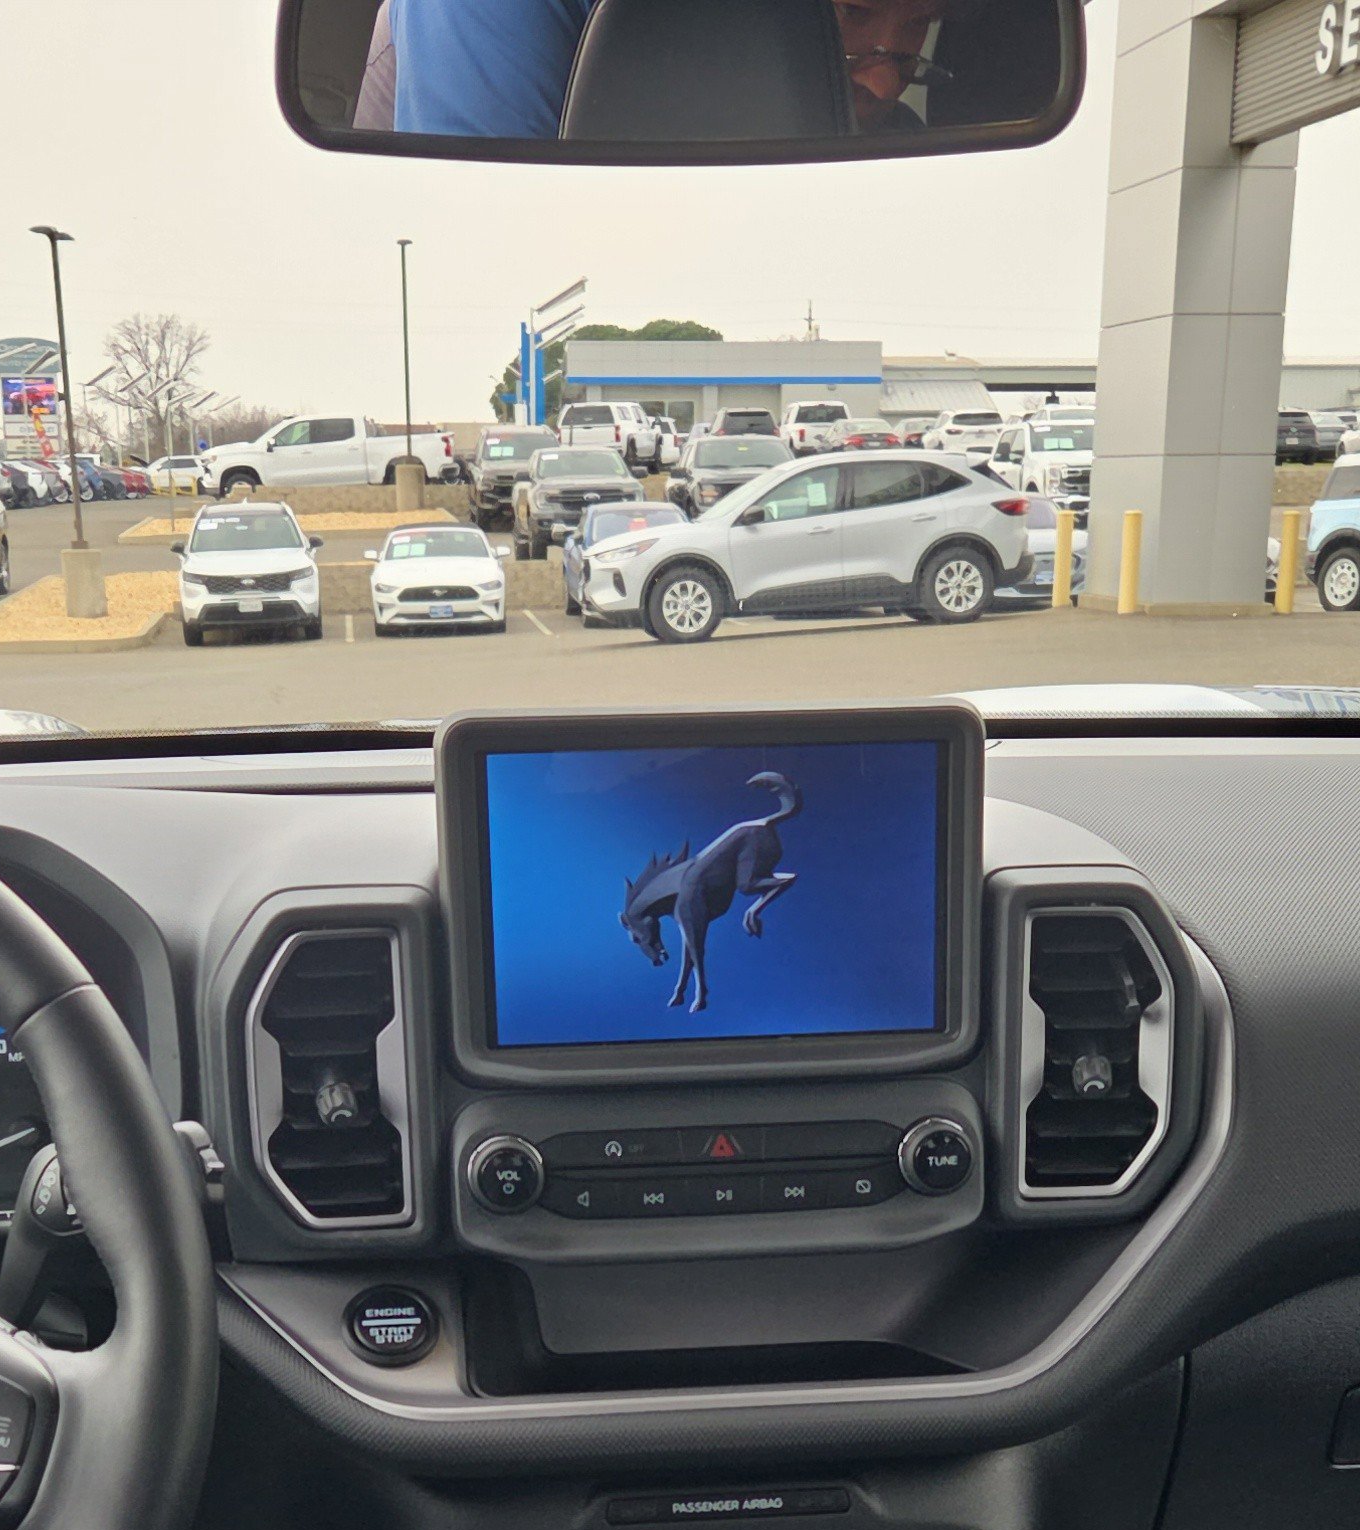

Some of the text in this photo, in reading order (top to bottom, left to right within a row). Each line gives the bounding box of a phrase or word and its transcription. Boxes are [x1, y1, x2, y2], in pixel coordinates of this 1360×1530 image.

[927, 1155, 958, 1167] TUNE
[496, 1170, 521, 1181] VOL
[365, 1307, 415, 1317] ENGINE
[369, 1326, 416, 1337] START
[375, 1334, 413, 1344] STOP
[672, 1498, 783, 1513] PASSENGER AIRBAG
